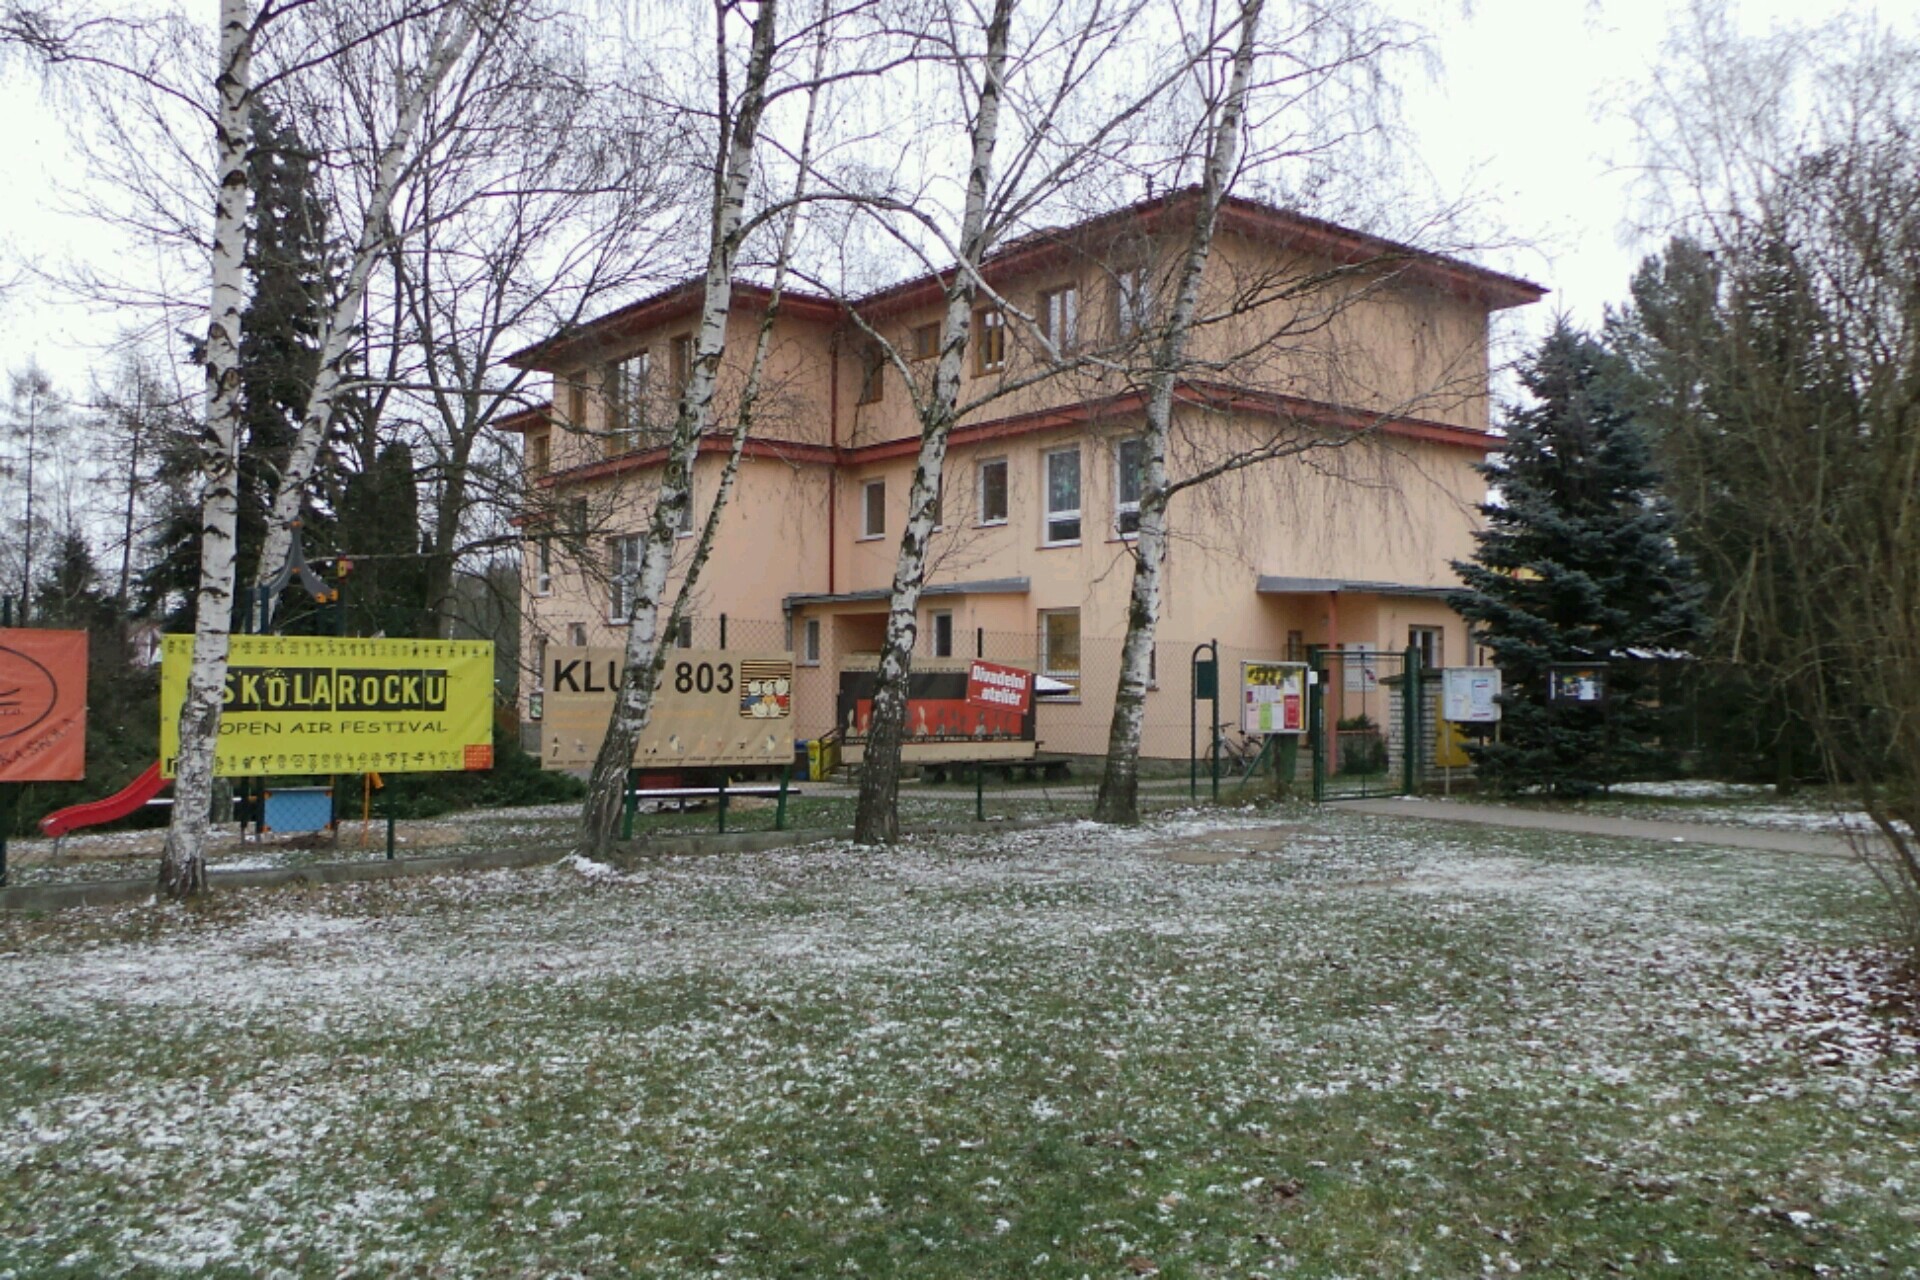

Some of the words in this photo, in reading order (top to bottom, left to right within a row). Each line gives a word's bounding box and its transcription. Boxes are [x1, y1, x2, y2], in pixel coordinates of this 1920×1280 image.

[338, 674, 446, 706] ROCKU
[553, 659, 662, 692] KLU
[675, 662, 734, 693] 803
[218, 721, 282, 735] OPEN
[289, 721, 333, 734] AIR
[340, 720, 448, 734] FESTIVAL
